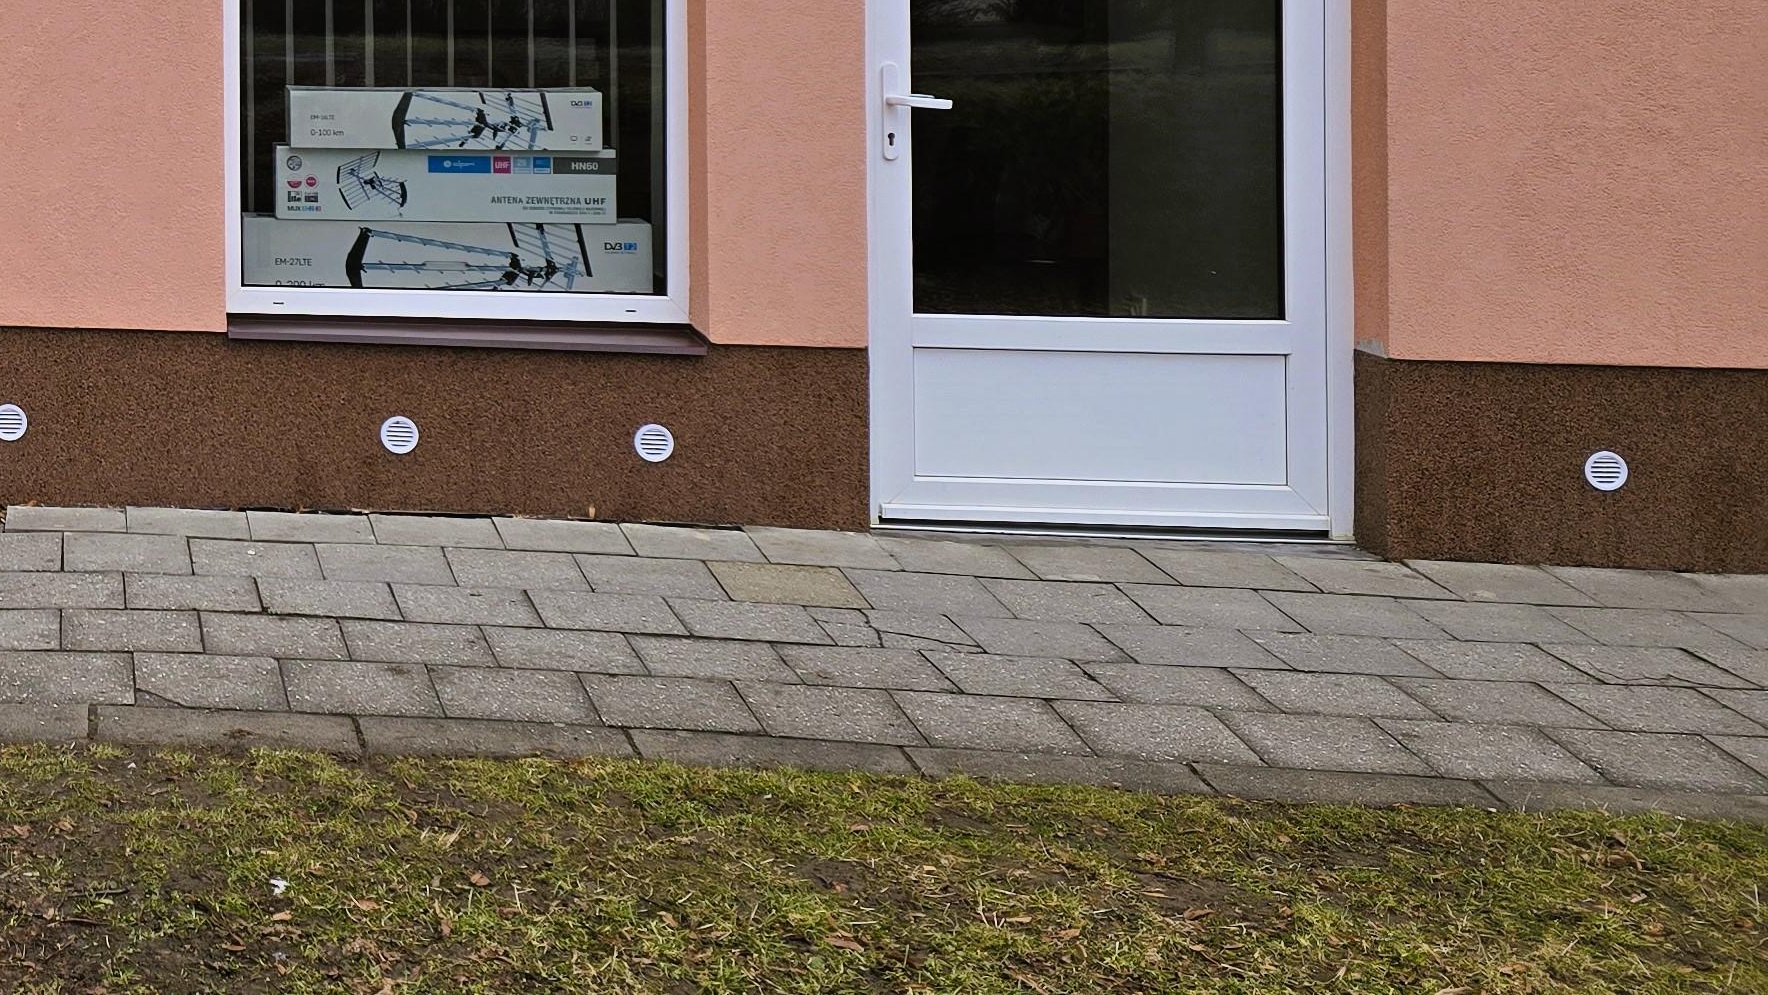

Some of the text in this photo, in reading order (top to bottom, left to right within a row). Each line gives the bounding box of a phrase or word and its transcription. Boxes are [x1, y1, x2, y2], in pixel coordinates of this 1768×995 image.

[494, 161, 509, 169] UHF
[490, 196, 524, 204] ANTENA
[584, 197, 607, 205] UHF
